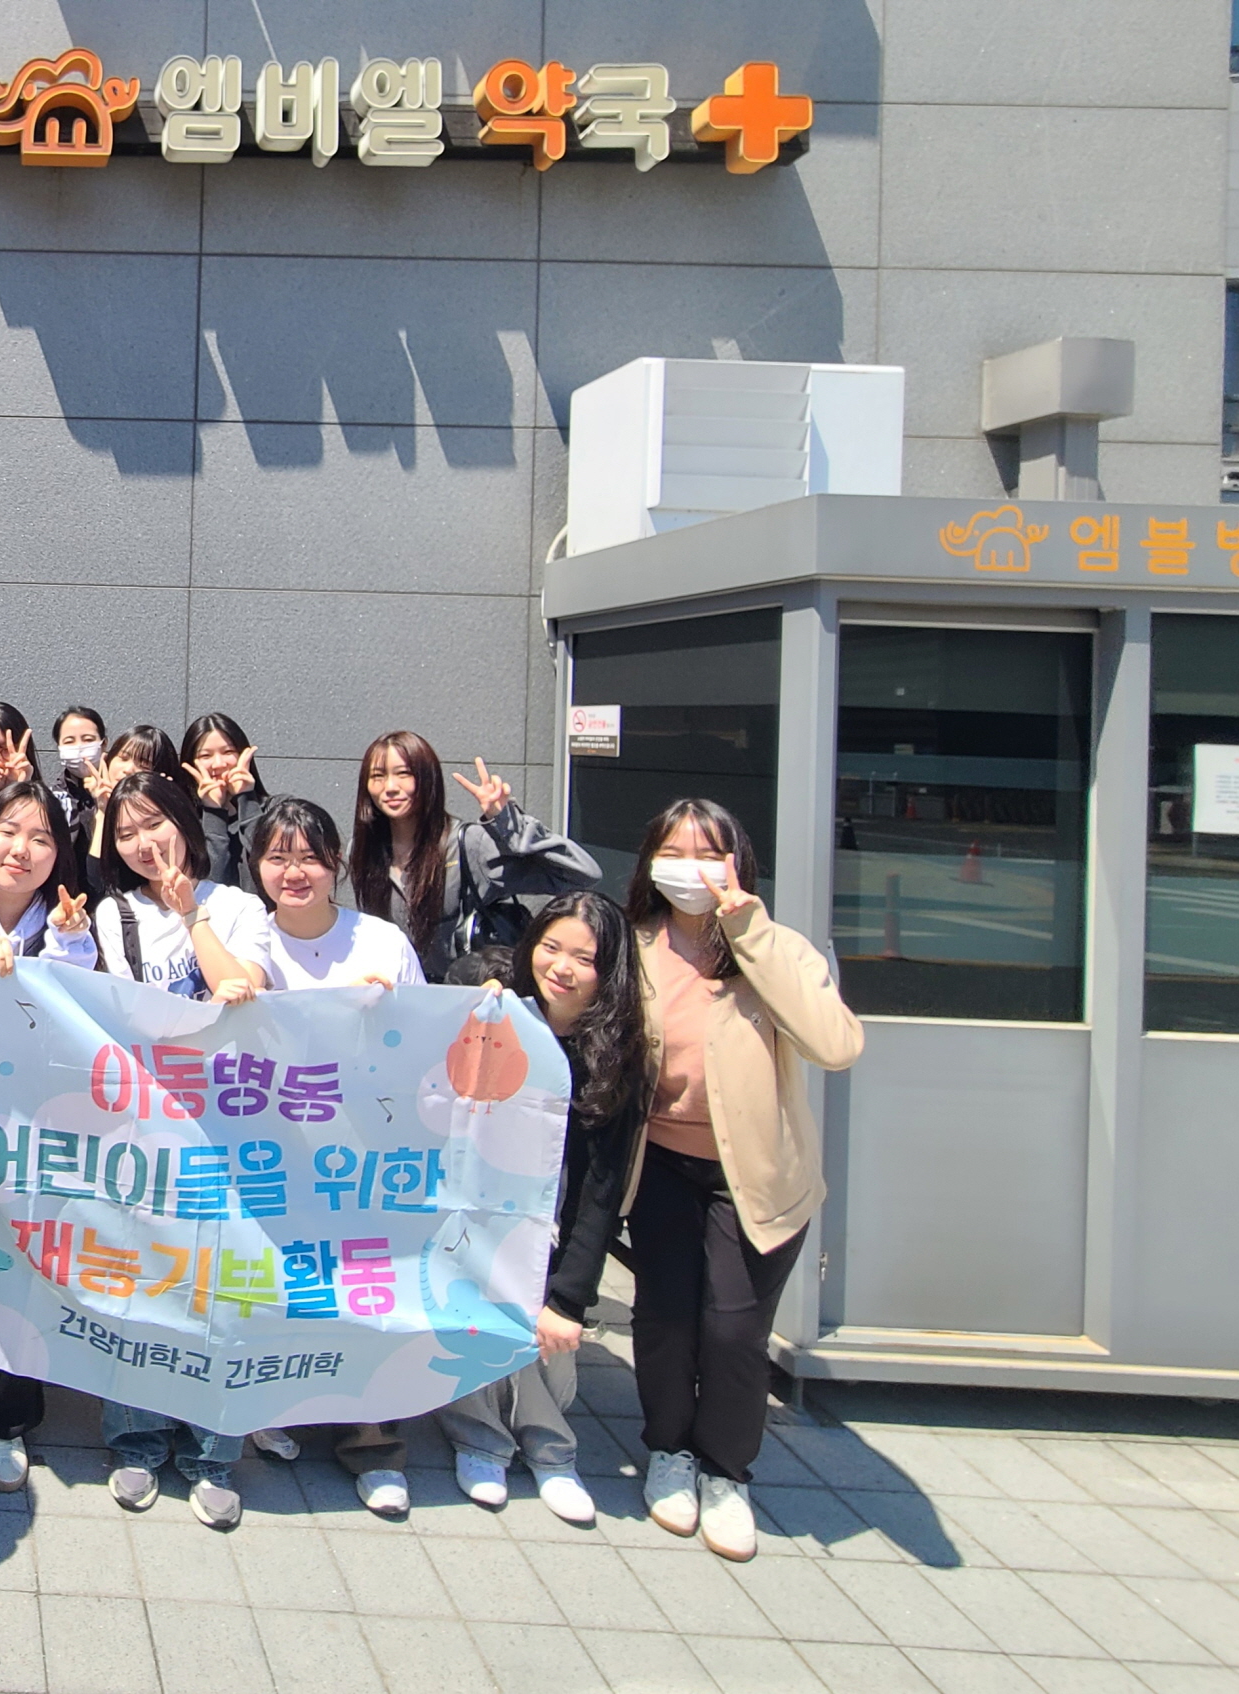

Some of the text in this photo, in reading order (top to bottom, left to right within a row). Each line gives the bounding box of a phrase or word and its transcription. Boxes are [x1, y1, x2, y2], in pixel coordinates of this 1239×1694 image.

[156, 55, 676, 172] 엠비엘 약국
[142, 962, 163, 984] To
[90, 1043, 343, 1122] 아동병동
[314, 1143, 446, 1213] 위한
[11, 1219, 396, 1319] 재능기부활동
[59, 1305, 344, 1389] 건양대학교 간호대학
